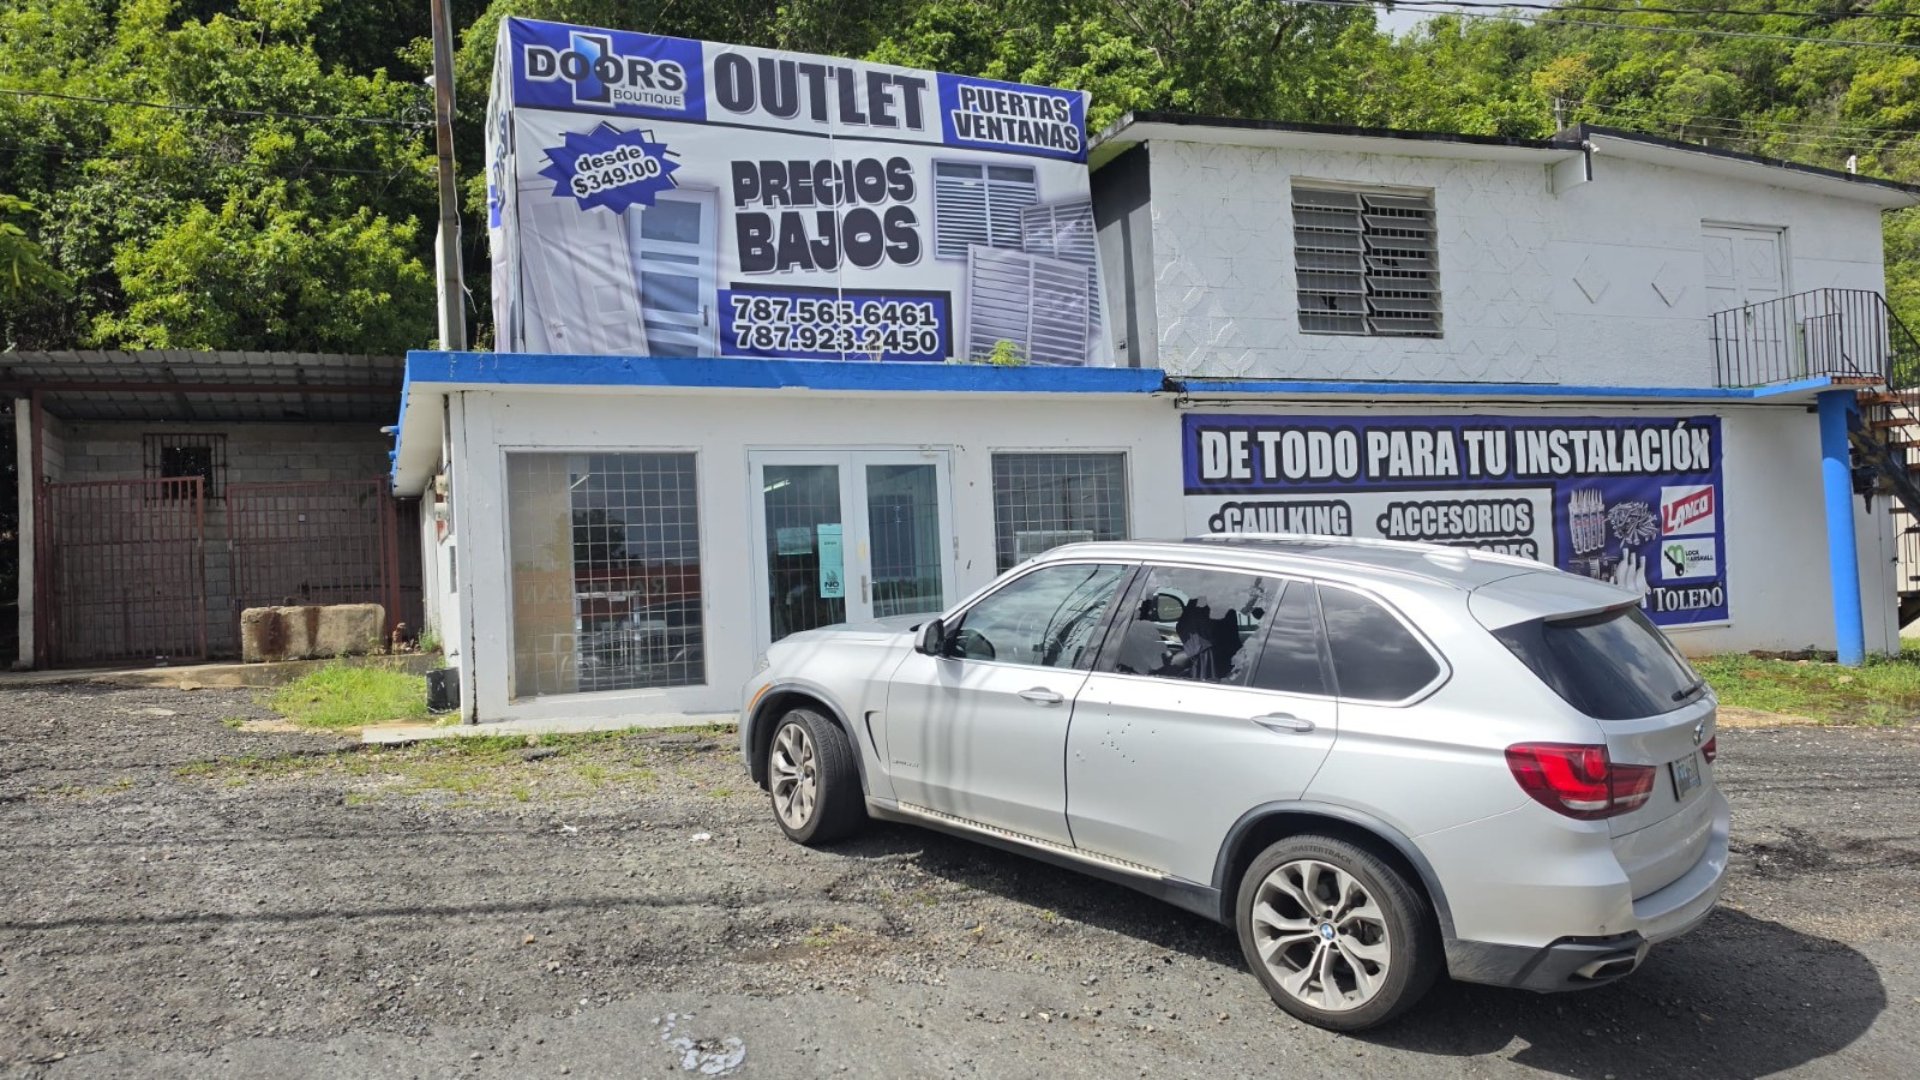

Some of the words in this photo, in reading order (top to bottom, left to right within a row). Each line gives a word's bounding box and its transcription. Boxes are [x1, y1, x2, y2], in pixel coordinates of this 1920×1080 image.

[527, 47, 684, 91] DOORS
[613, 89, 682, 106] BOUTIQUE
[713, 53, 927, 130] OUTLET
[960, 86, 1070, 122] PUERTAS
[954, 113, 1080, 151] VENTANAS
[573, 158, 658, 195] $349.00
[578, 147, 642, 172] desde
[731, 156, 915, 207] PRECIOS
[735, 205, 921, 272] BAJOS
[733, 298, 936, 326] 787.565.6461
[734, 324, 937, 351] 787.923.2450
[1202, 431, 1251, 479] DE
[1257, 430, 1358, 479] TODO
[1367, 430, 1459, 477] PARA
[1464, 430, 1507, 476] TU
[1515, 421, 1710, 474] INSTALACIÓN
[1224, 505, 1348, 535] CAULKING
[1390, 502, 1531, 536] ACCESORIOS
[1662, 495, 1709, 534] LANCO
[1653, 586, 1723, 612] TOLEDO
